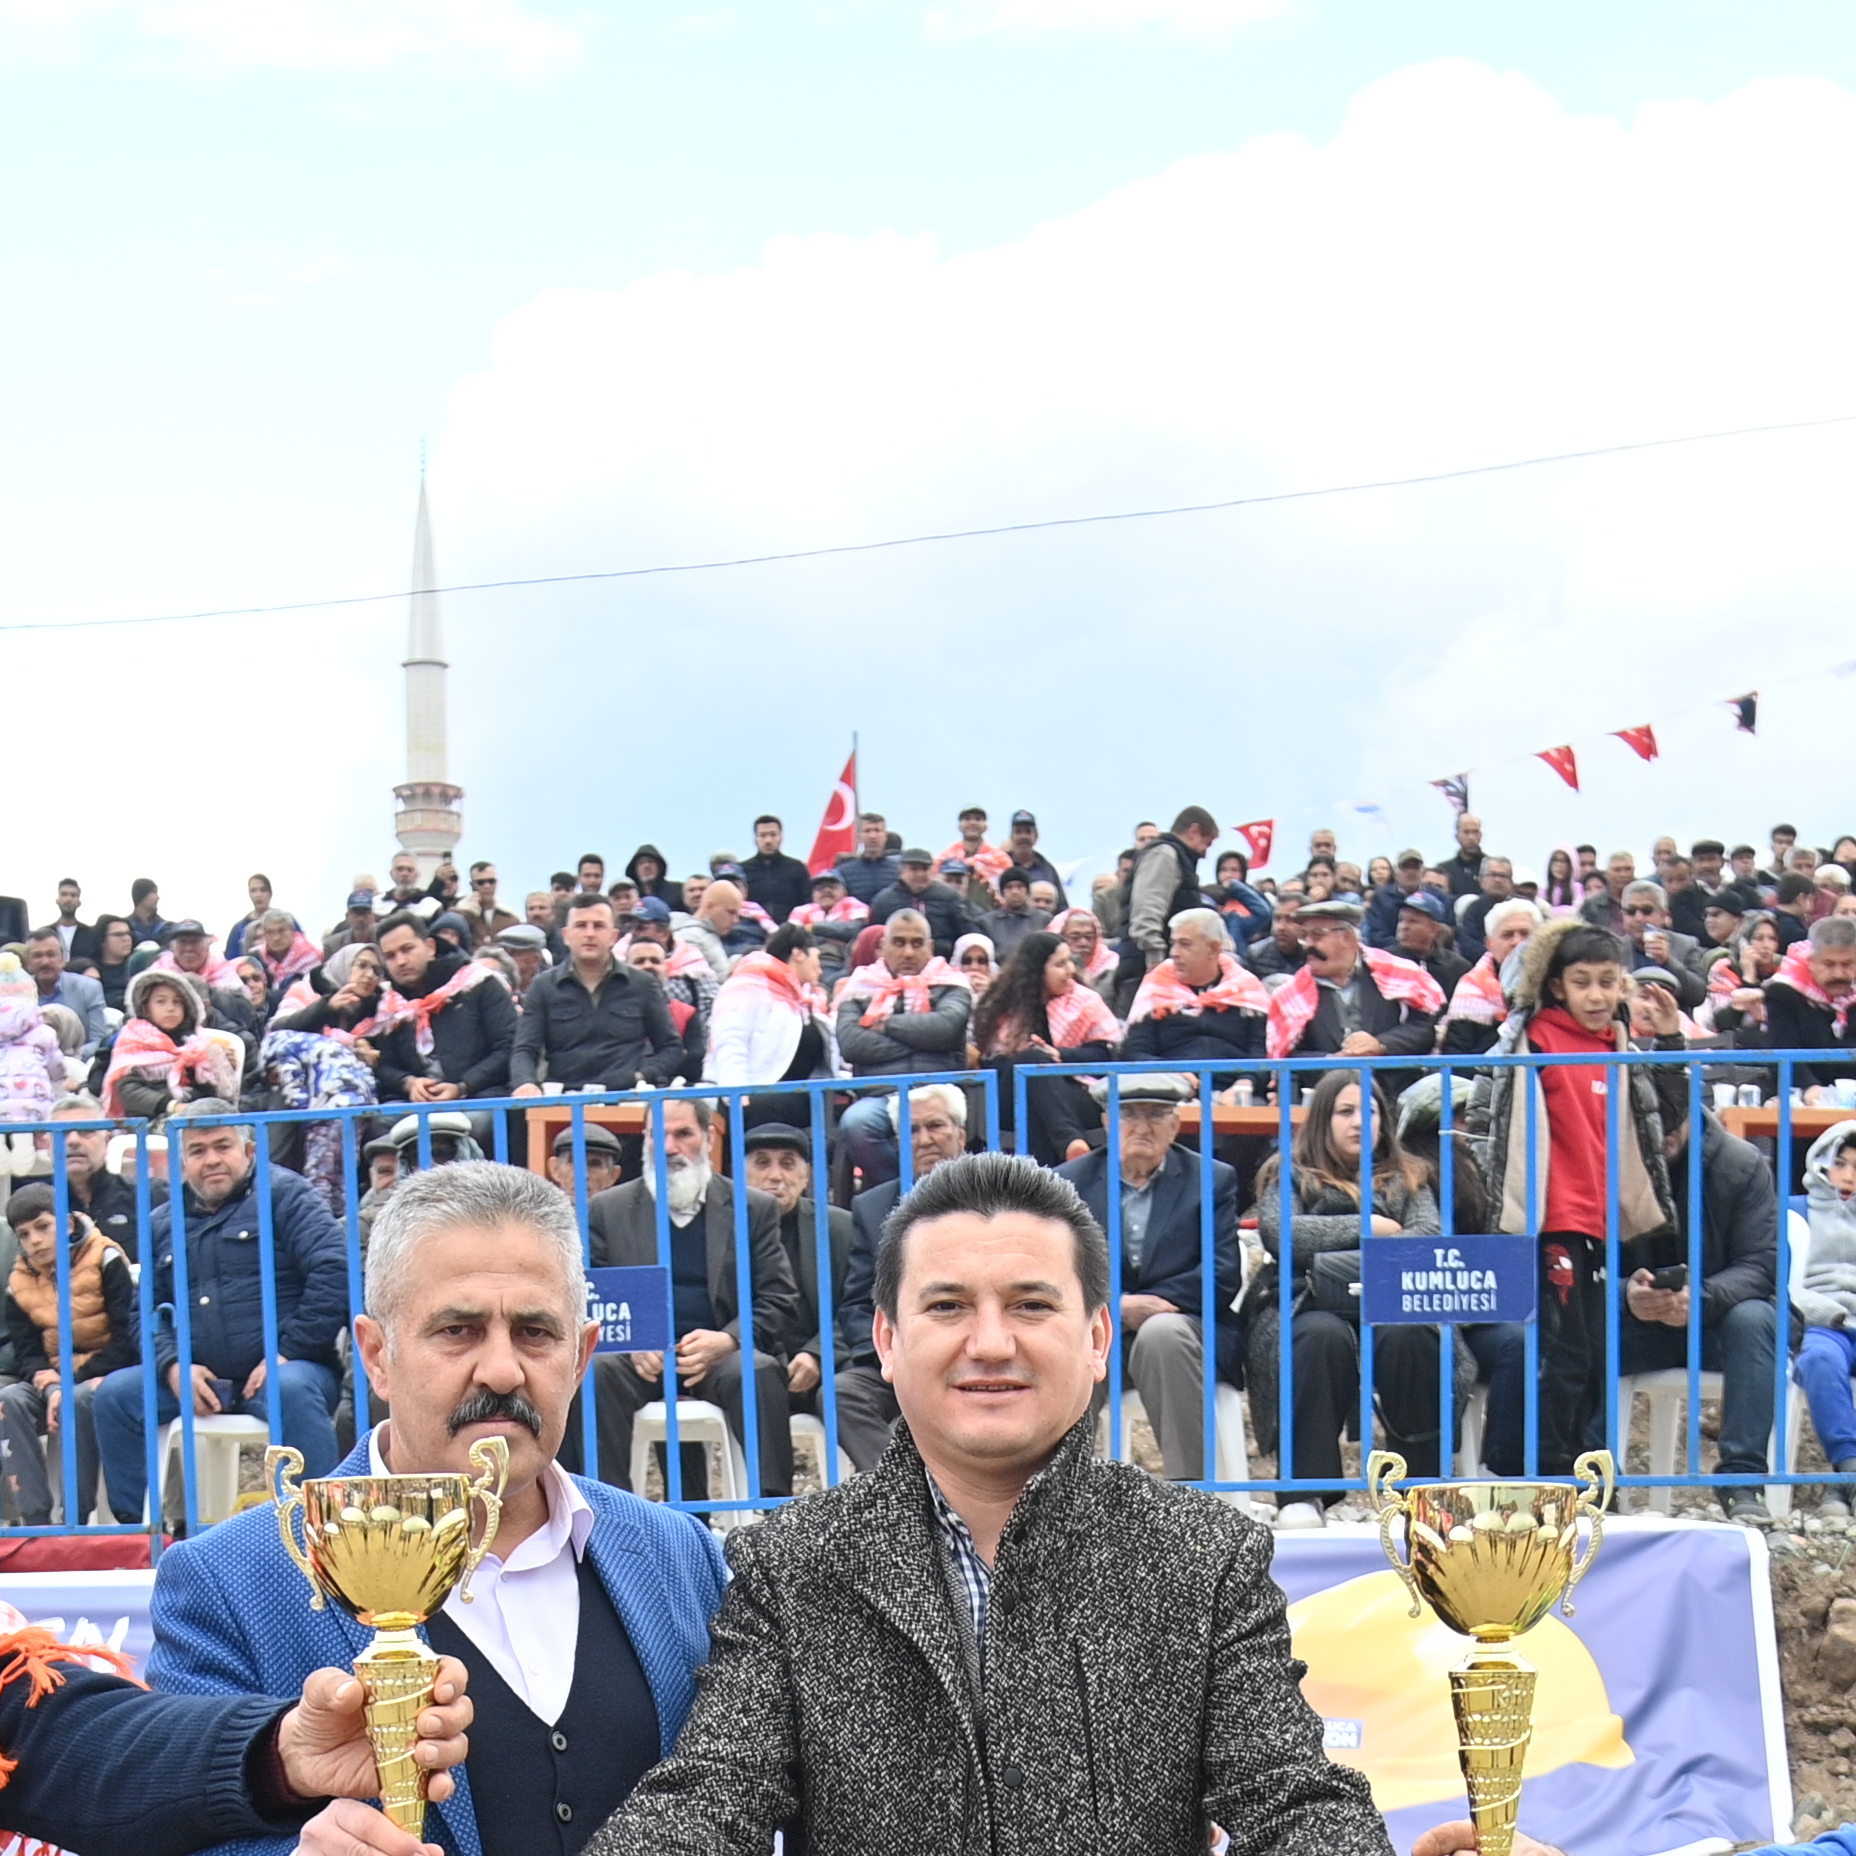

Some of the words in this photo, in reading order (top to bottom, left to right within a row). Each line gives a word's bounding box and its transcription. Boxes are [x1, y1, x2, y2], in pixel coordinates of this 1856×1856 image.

[1433, 1248, 1466, 1268] T.C.
[1401, 1270, 1498, 1291] KUMLUCA
[1402, 1290, 1497, 1312] BELEDİYESİ
[585, 1302, 631, 1322] LUCA
